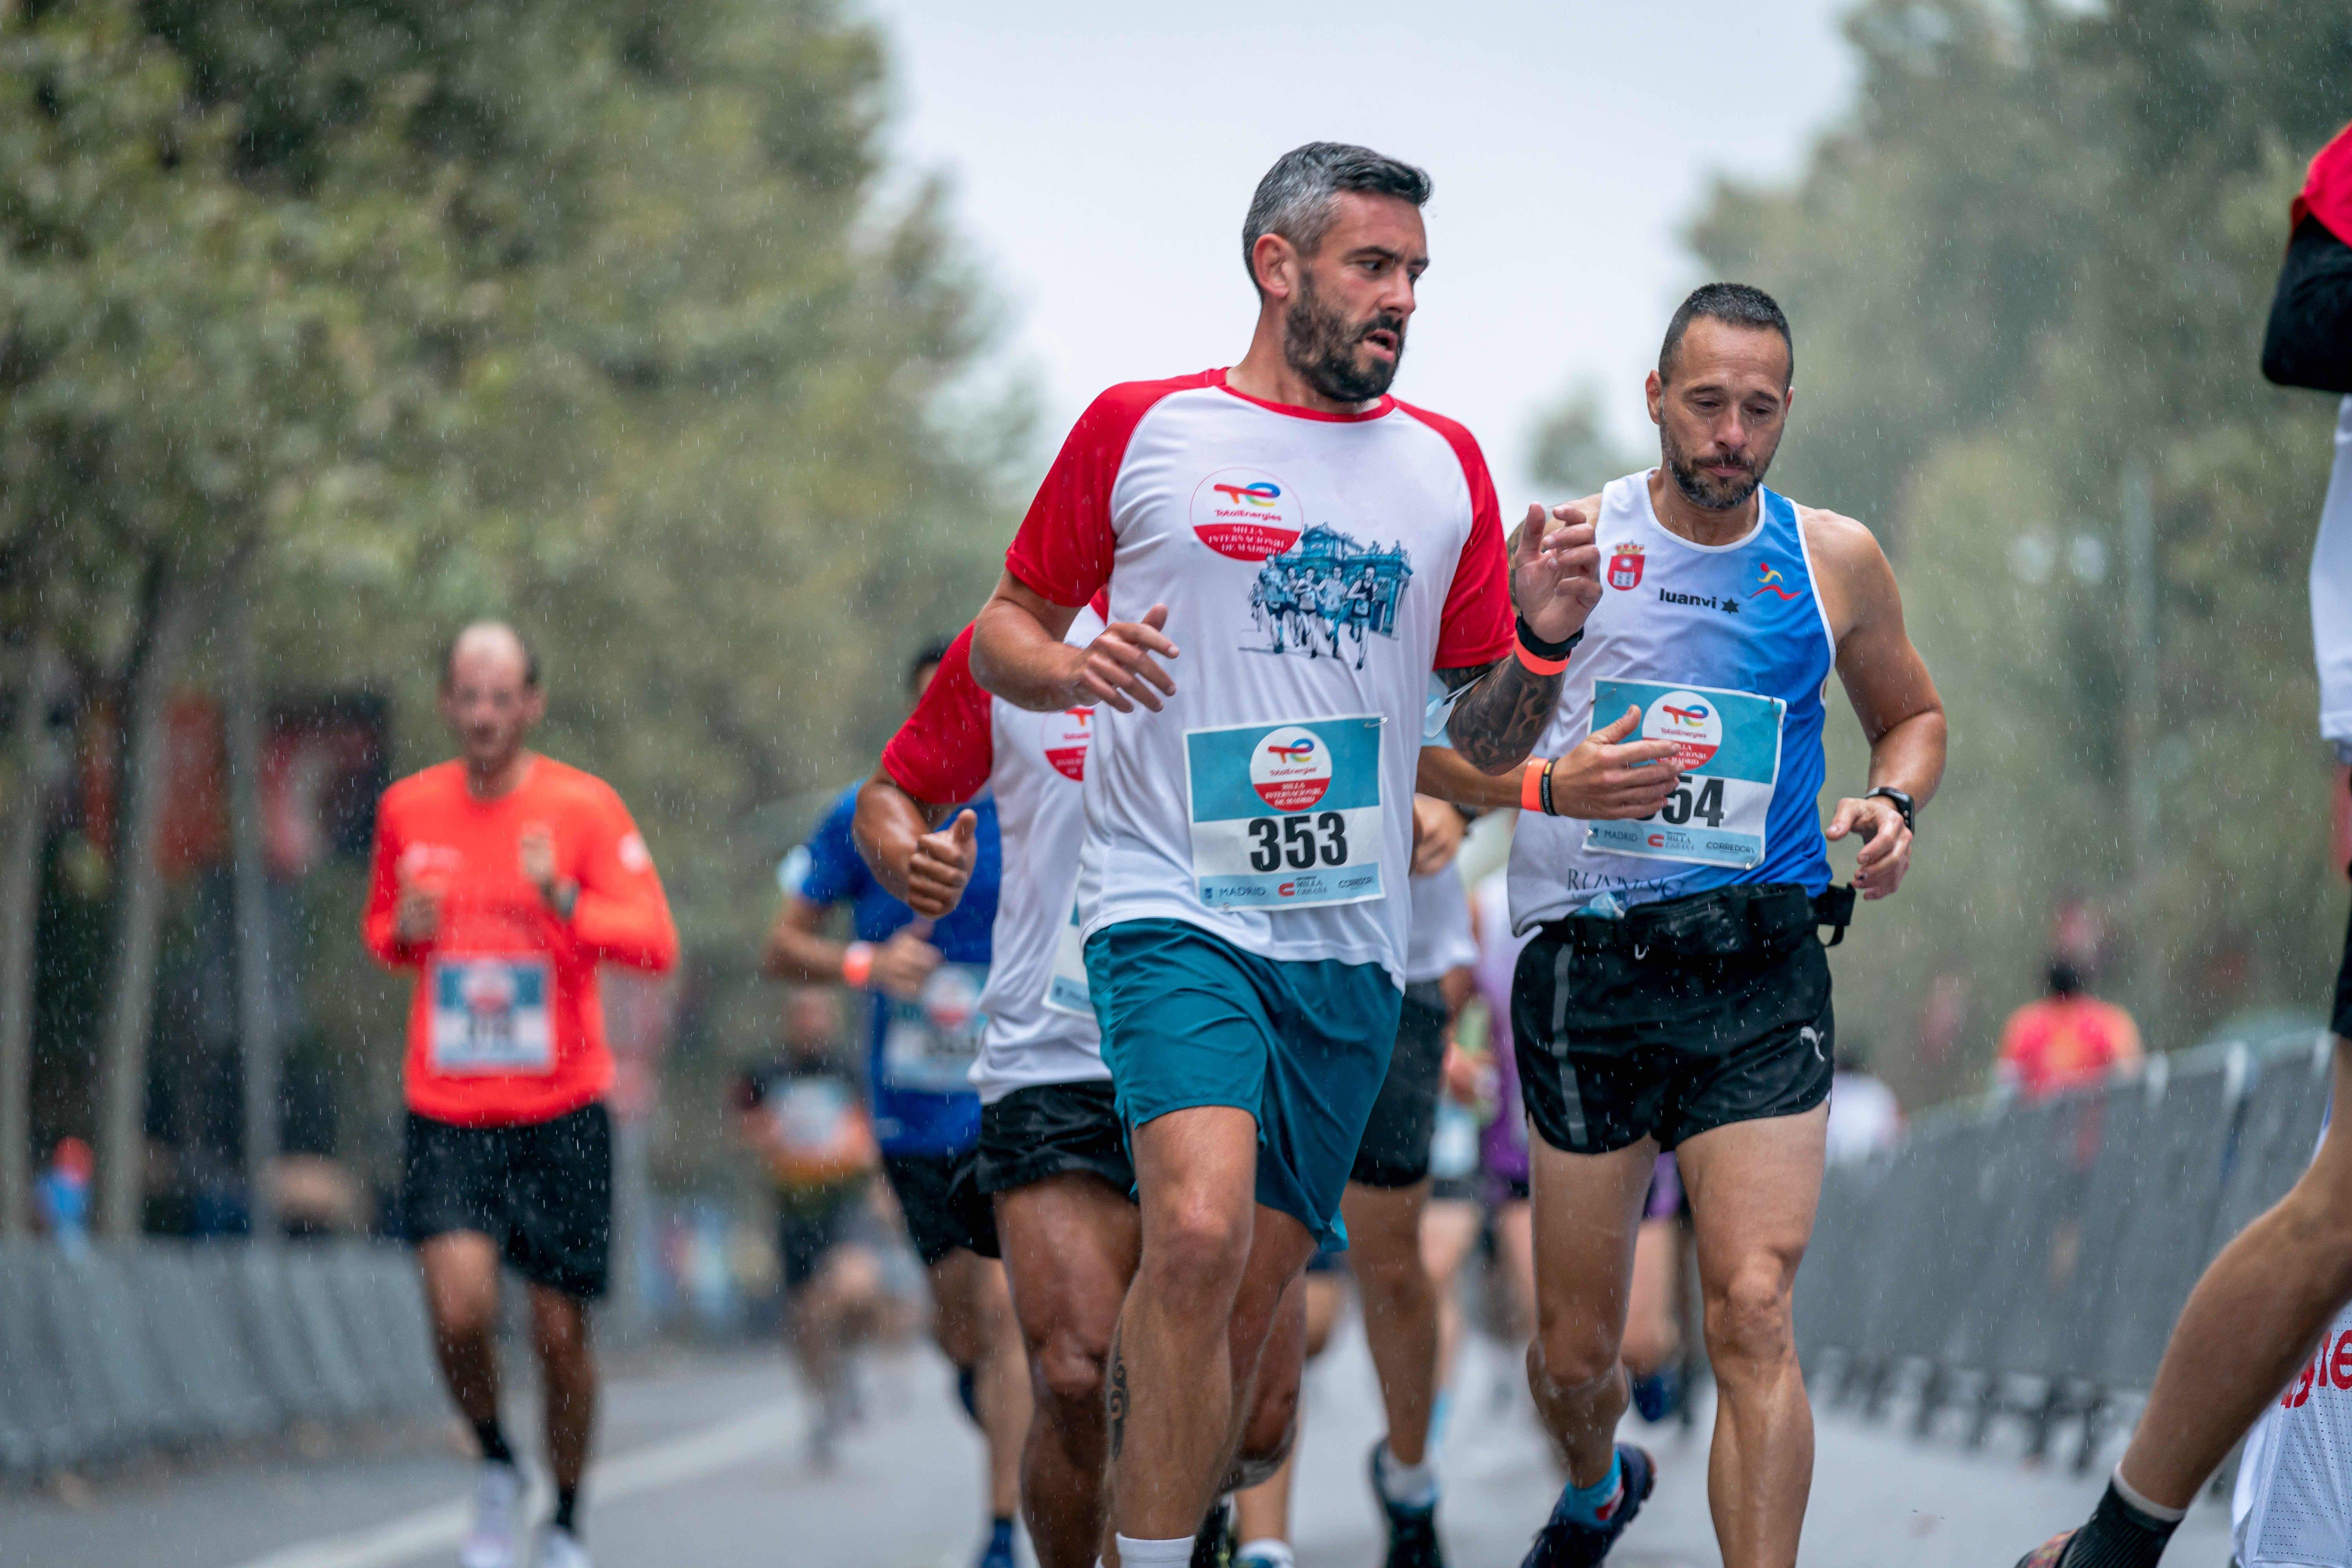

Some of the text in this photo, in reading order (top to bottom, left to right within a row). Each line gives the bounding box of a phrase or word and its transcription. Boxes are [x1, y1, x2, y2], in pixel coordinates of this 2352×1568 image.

[1660, 727, 1706, 738] TotalEnergies
[1635, 775, 1724, 827] 54
[1248, 812, 1348, 871] 353
[1604, 830, 1638, 842] MADRID
[1219, 886, 1266, 898] MADRID
